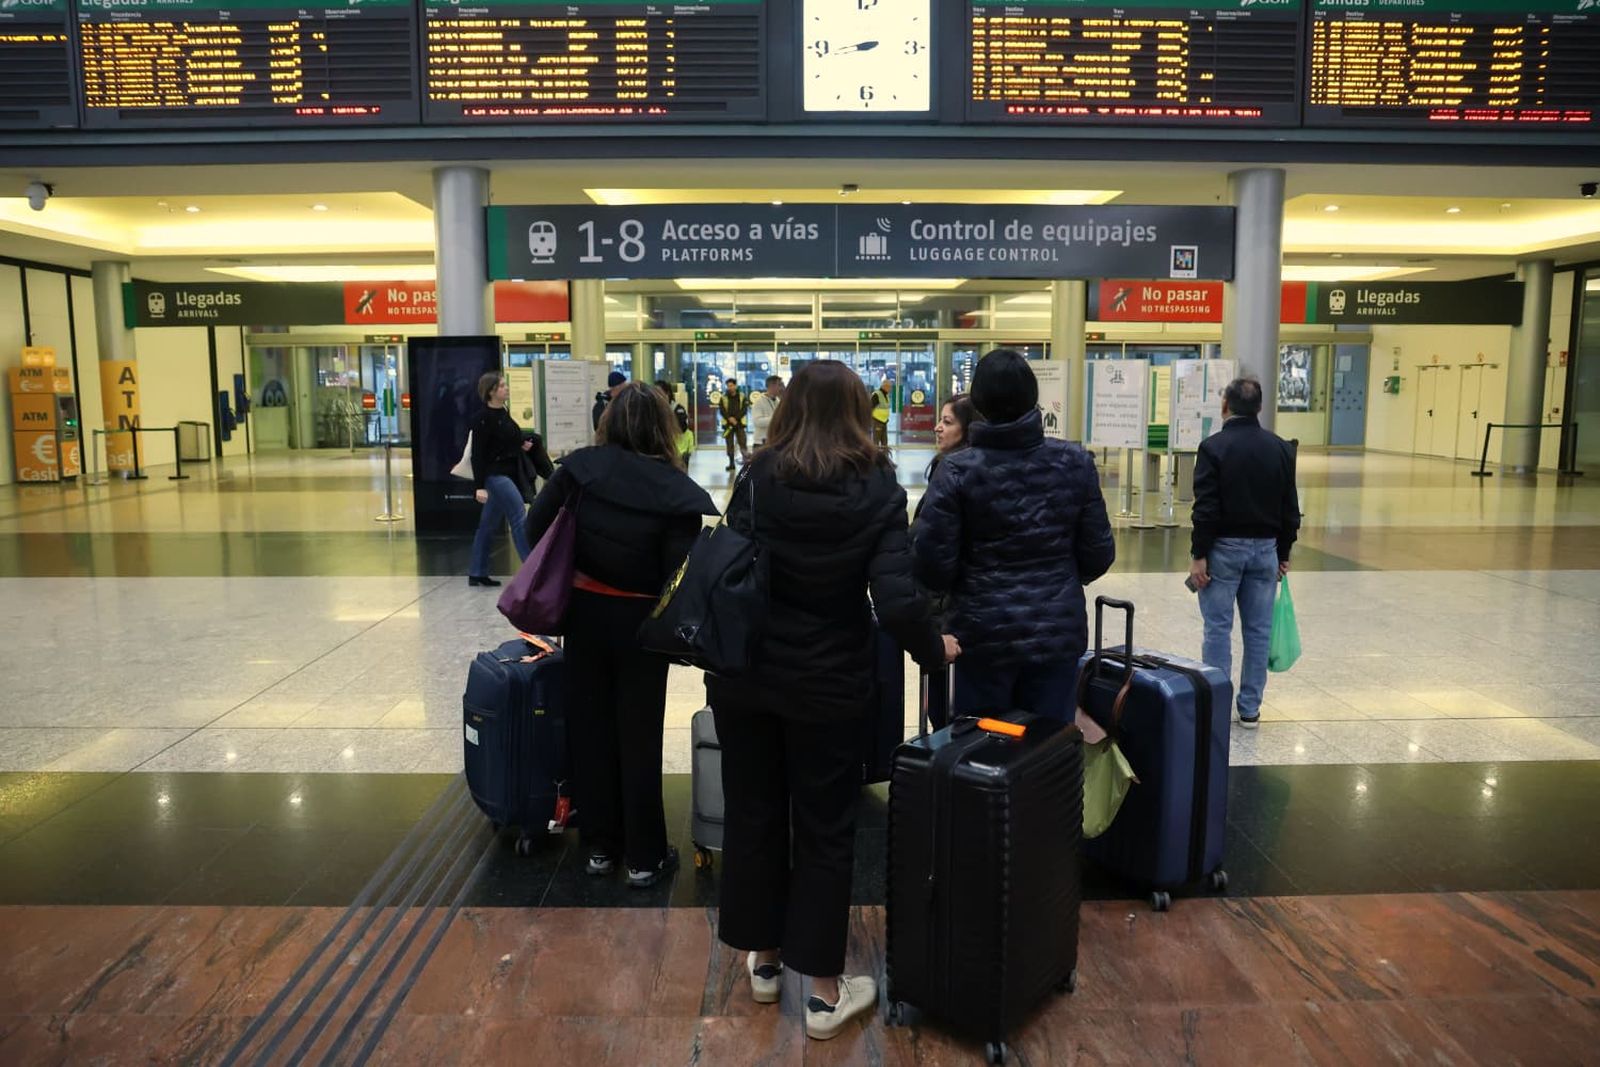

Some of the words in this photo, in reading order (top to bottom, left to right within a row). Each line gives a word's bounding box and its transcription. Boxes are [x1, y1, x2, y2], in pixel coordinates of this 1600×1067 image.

[815, 40, 829, 58] 9
[904, 40, 918, 54] 3
[860, 85, 874, 100] 6
[577, 219, 646, 263] 1-8
[661, 219, 741, 240] Acceso
[749, 223, 762, 240] a
[771, 217, 819, 240] vías
[909, 218, 996, 241] Control
[1004, 218, 1033, 241] de
[1042, 218, 1157, 247] equipajes
[661, 248, 753, 262] PLATFORMS
[909, 248, 985, 262] LUGGAGE
[988, 248, 1059, 262] CONTROL
[175, 291, 242, 309] Llegadas
[387, 288, 407, 303] No
[1142, 286, 1161, 301] No
[1167, 288, 1208, 304] pasar
[1356, 289, 1421, 306] Llegadas
[177, 309, 219, 318] ARRIVALS
[387, 306, 400, 315] NO
[1141, 305, 1153, 313] NO
[1155, 305, 1211, 314] TRESPASSING
[1356, 307, 1397, 316] ARRIVALS
[19, 368, 43, 377] ATM
[118, 366, 140, 431] ATM
[22, 411, 48, 421] ATM
[20, 466, 59, 481] Cash
